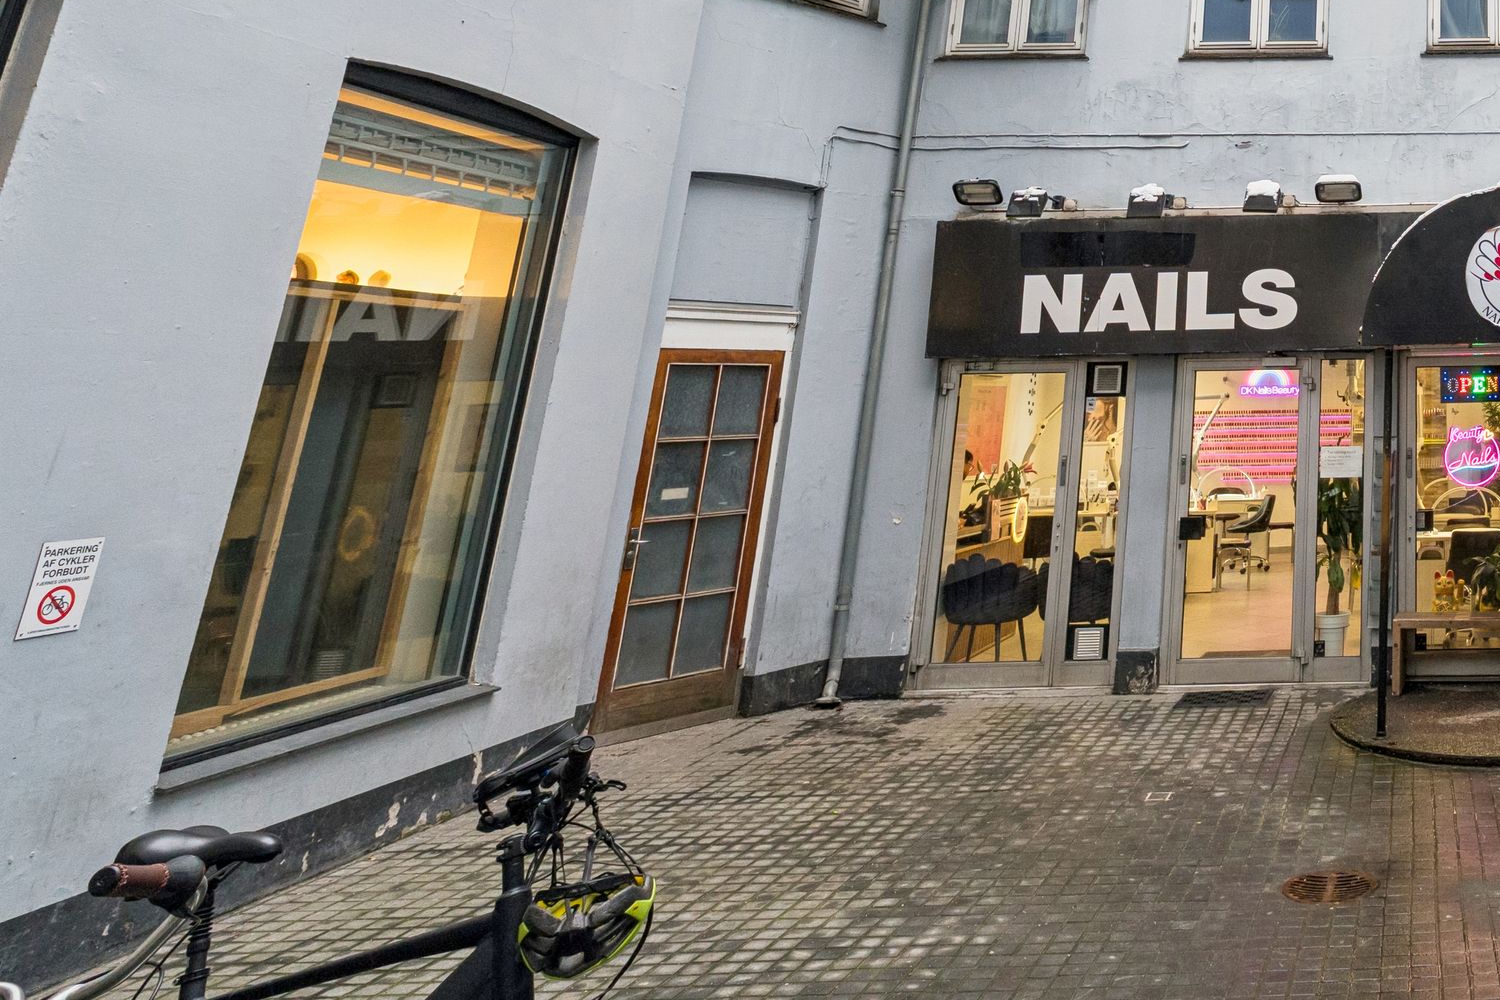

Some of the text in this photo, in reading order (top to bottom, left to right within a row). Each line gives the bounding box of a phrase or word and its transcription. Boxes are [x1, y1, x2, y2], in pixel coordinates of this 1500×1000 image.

[1020, 268, 1298, 334] NAILS
[1240, 387, 1253, 395] DK
[1272, 386, 1299, 396] Beauty
[1447, 376, 1499, 393] OPEN
[1450, 425, 1484, 443] Beauty
[1449, 446, 1498, 470] Nails
[44, 545, 99, 557] PARKERING
[42, 555, 96, 568] AF CYKLER
[42, 565, 89, 578] FORBUDT
